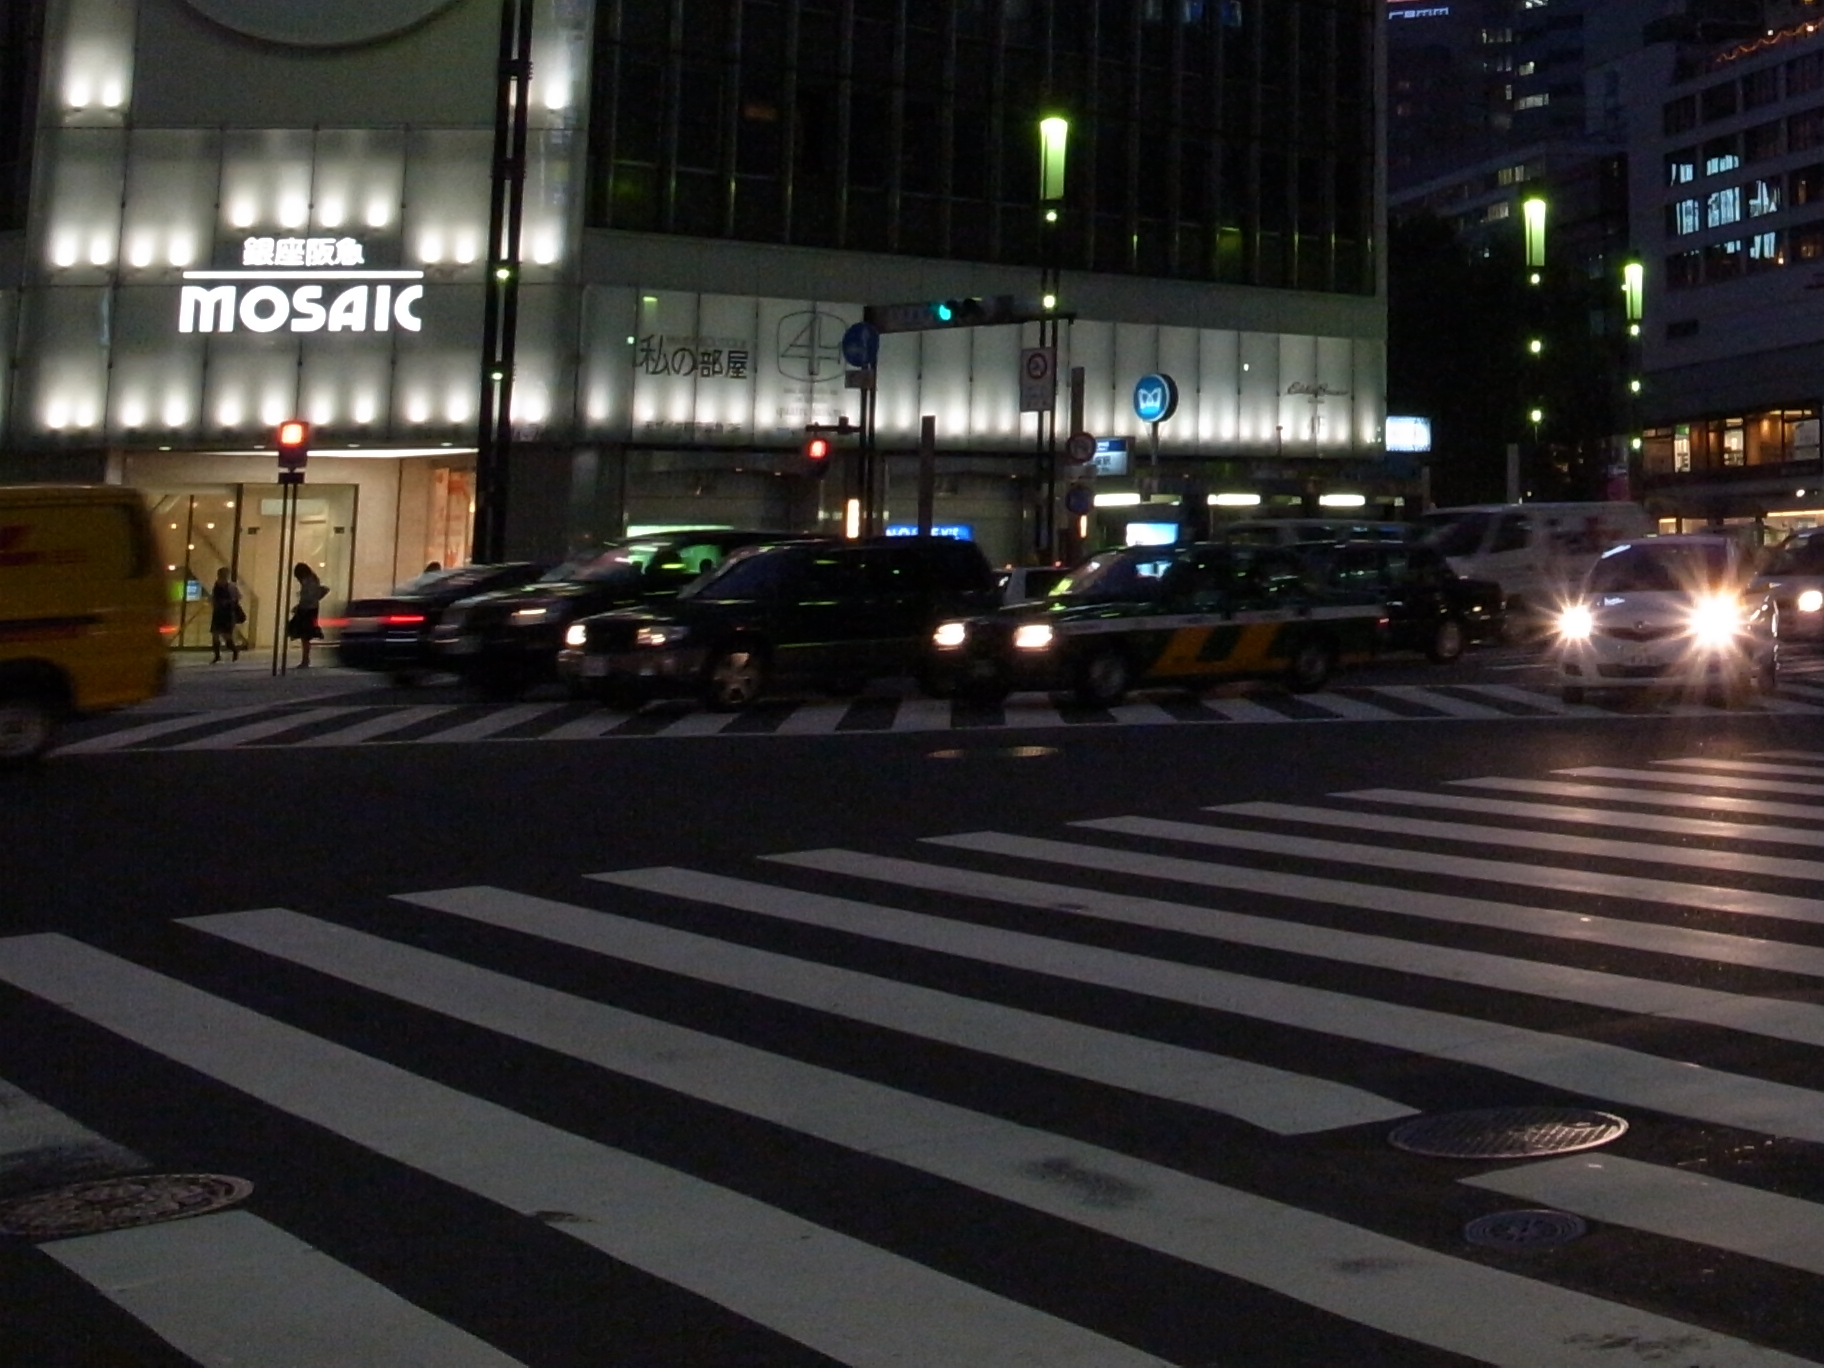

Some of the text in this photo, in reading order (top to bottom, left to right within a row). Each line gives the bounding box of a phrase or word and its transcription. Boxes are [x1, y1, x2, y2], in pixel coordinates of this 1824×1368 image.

[243, 237, 365, 267] 銀座阪急
[178, 284, 424, 333] MOSAIC
[636, 334, 749, 379] 私の部屋
